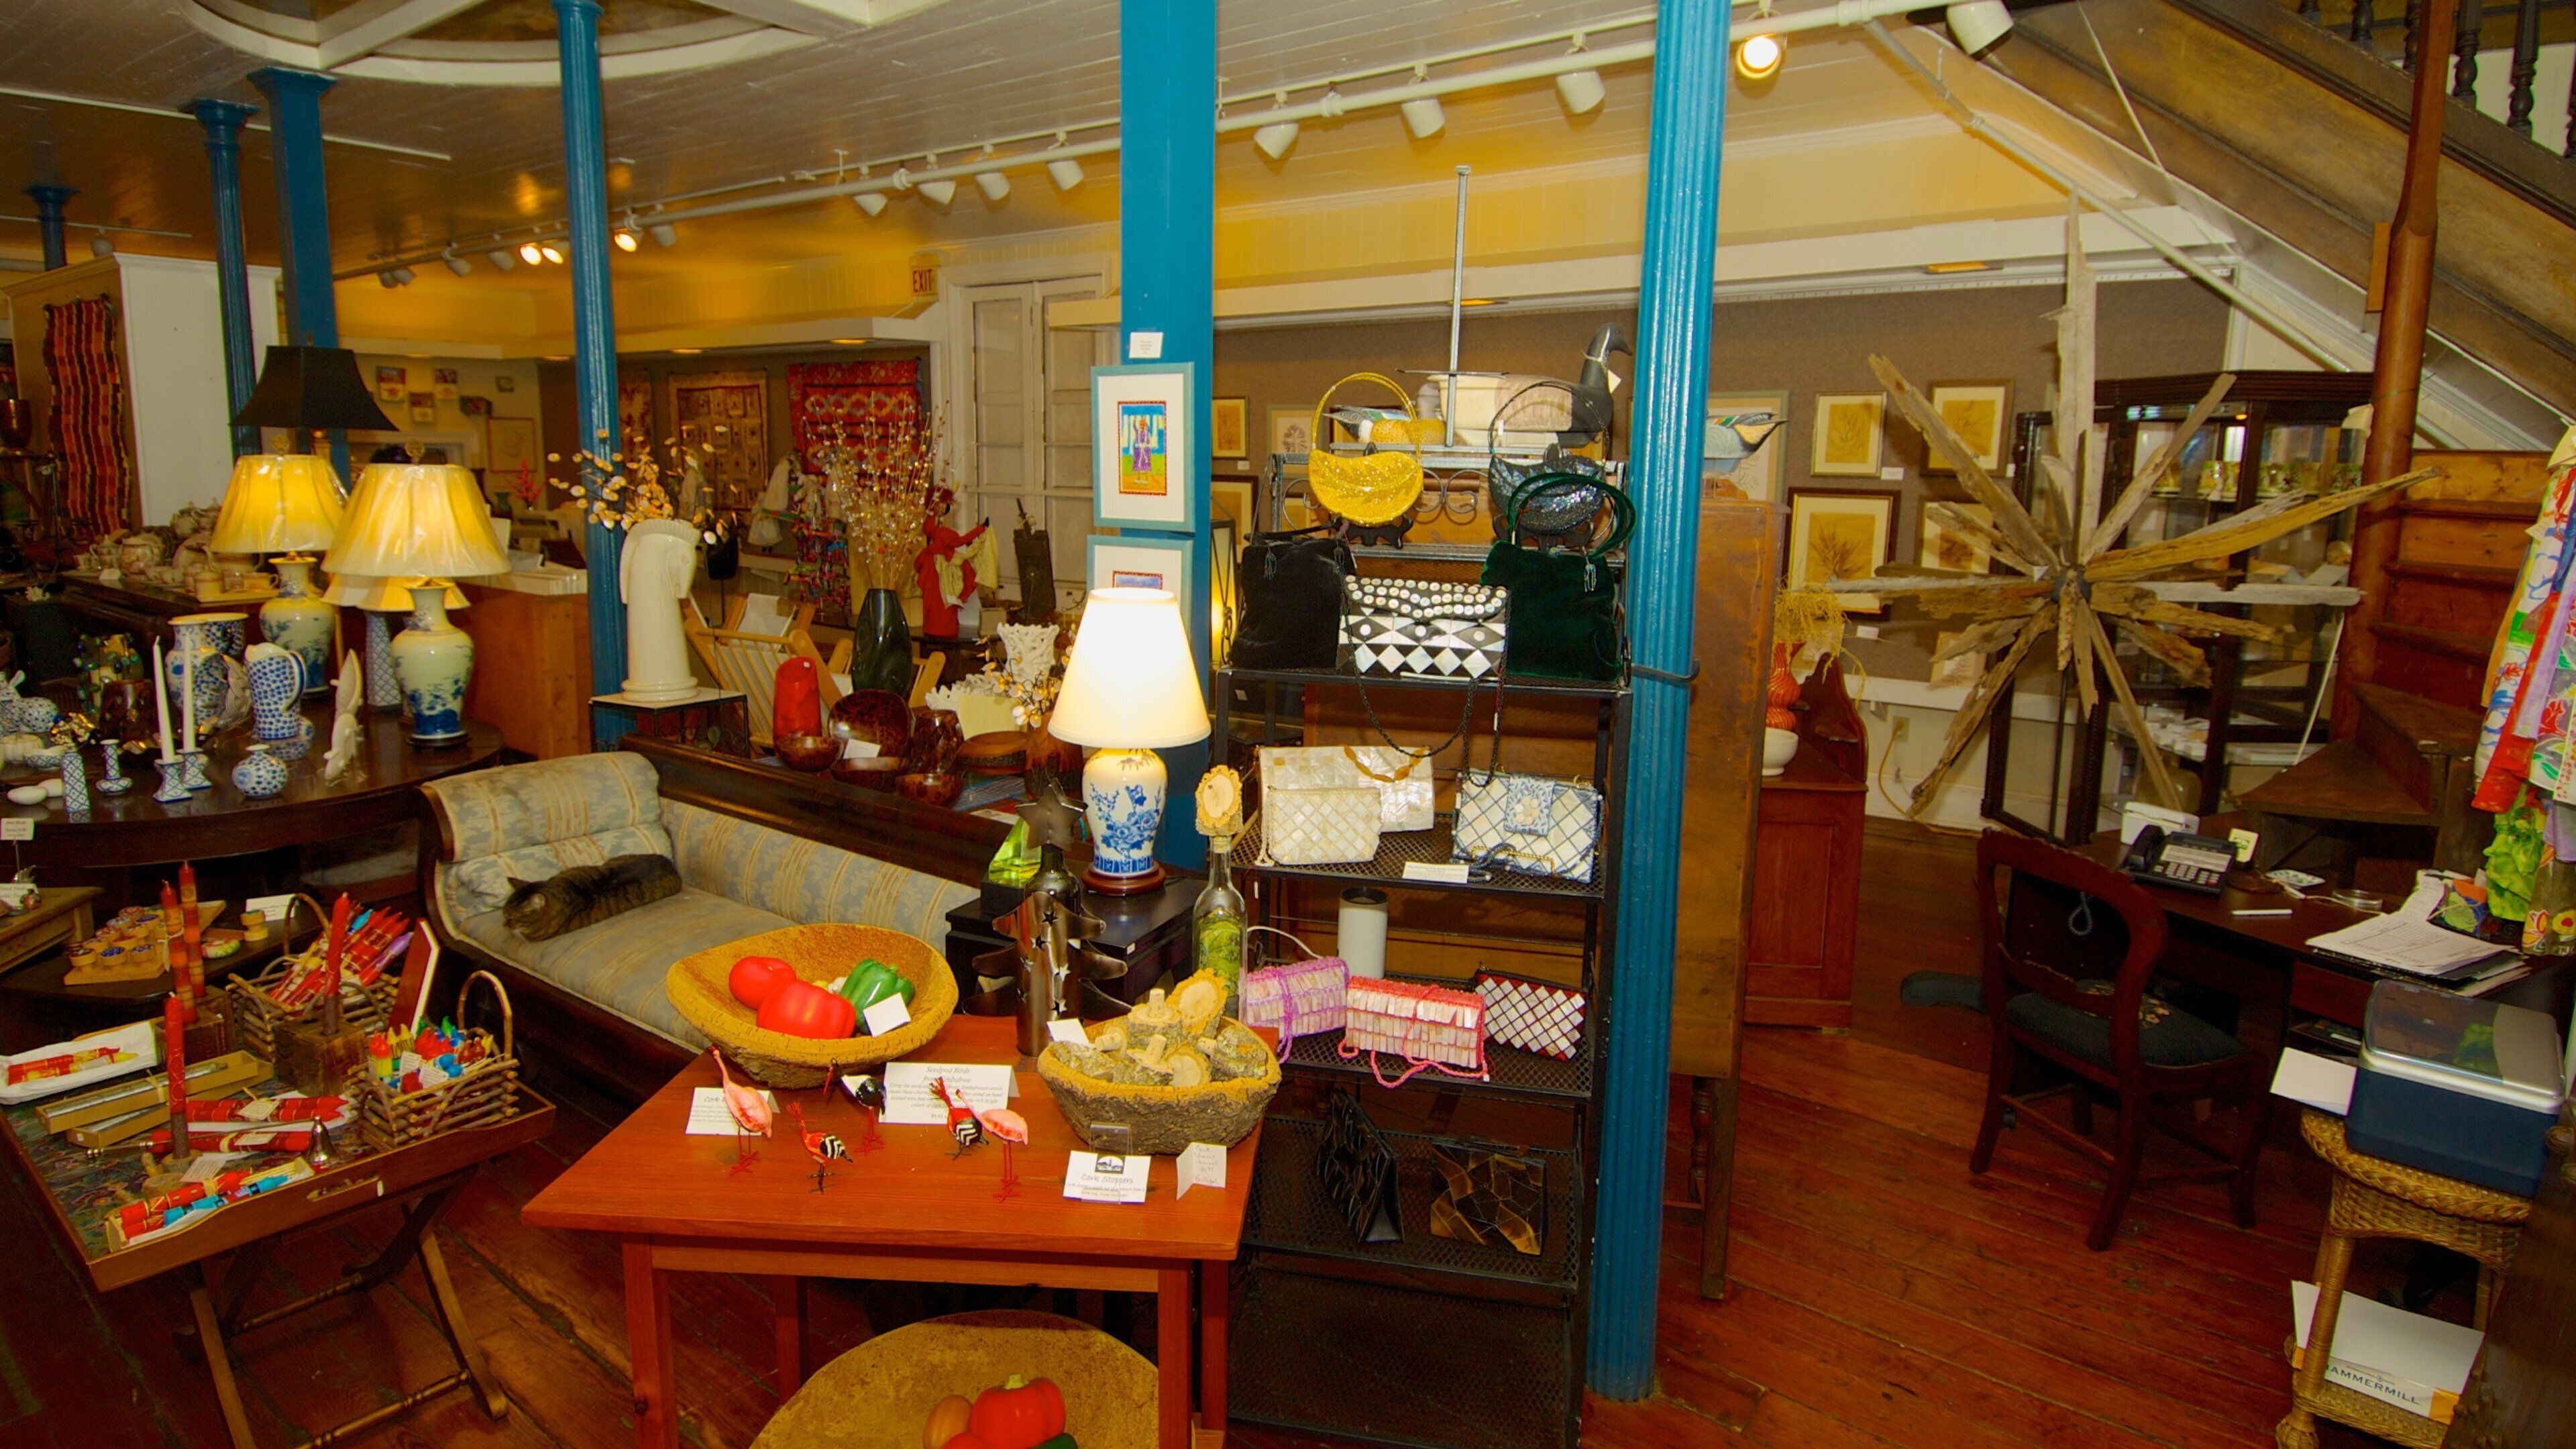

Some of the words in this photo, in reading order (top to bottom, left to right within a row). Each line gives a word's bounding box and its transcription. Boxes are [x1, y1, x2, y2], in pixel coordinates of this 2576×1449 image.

[912, 268, 932, 292] EXIT
[1081, 1173, 1099, 1182] Cork
[1102, 1175, 1134, 1185] Stoppers
